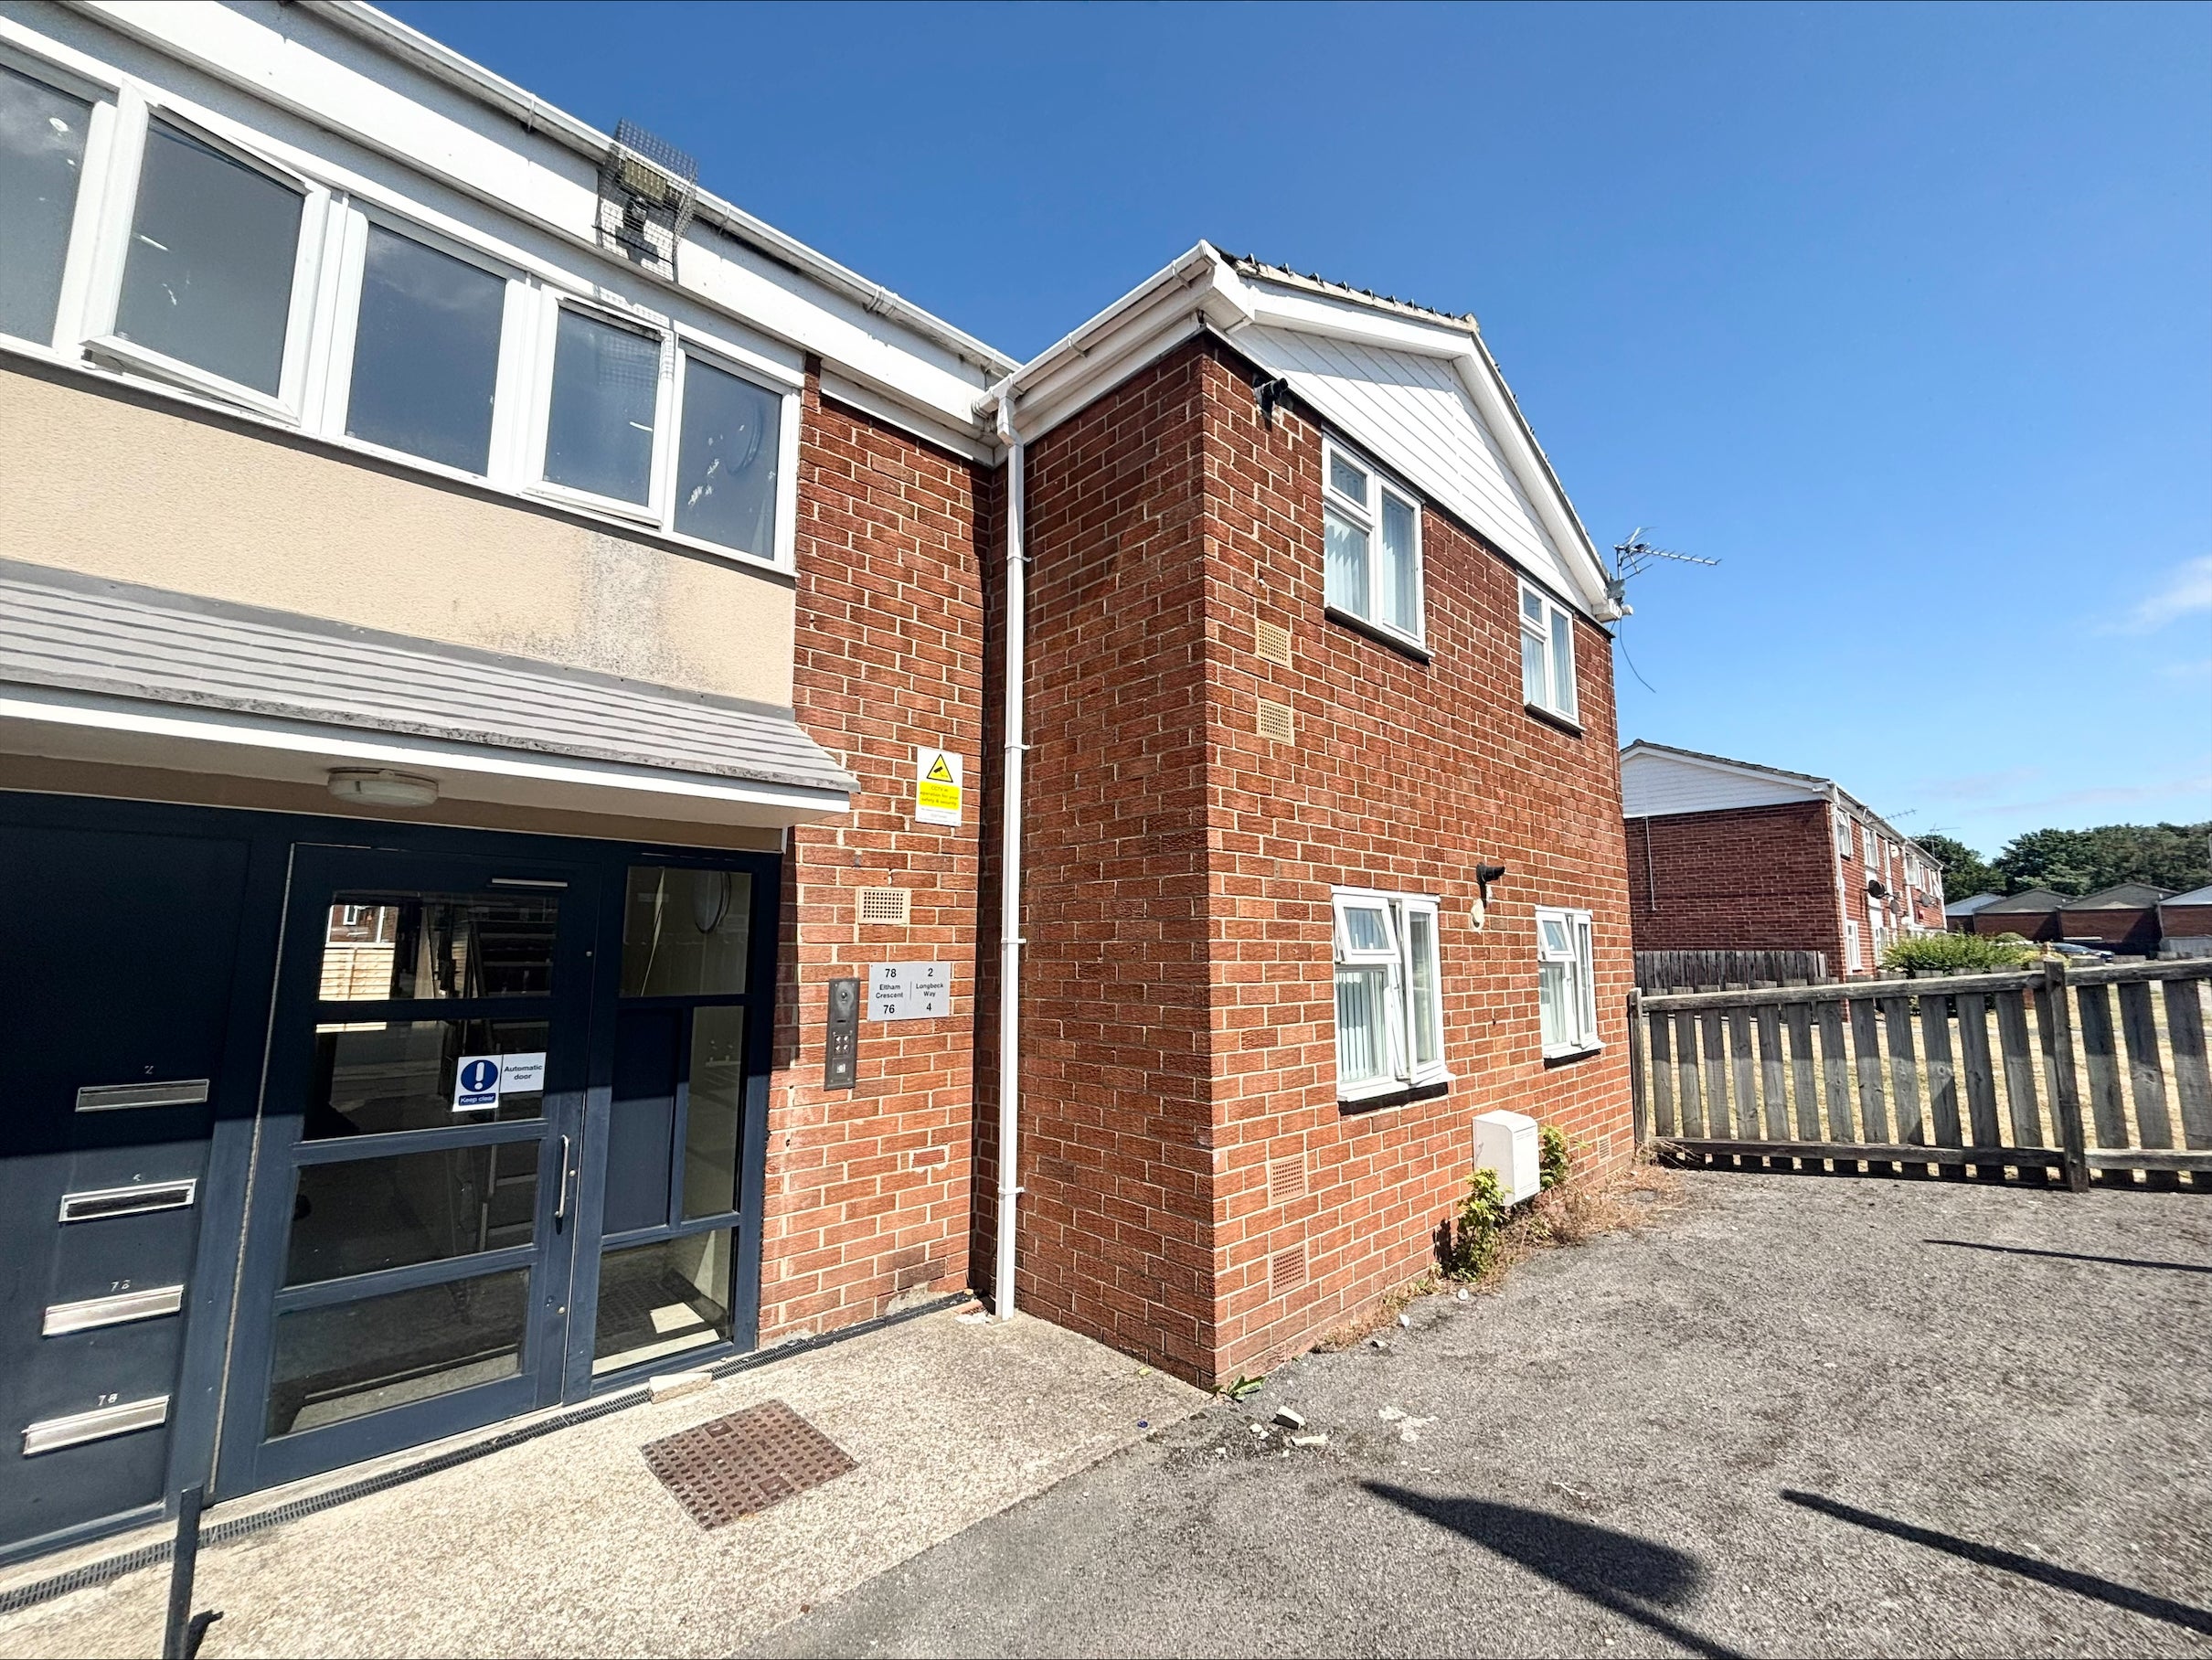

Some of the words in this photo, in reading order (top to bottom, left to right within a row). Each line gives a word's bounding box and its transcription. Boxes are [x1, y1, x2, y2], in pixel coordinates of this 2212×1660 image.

[885, 968, 897, 978] 78
[928, 968, 933, 977] 2
[883, 1005, 895, 1014] 76
[926, 1003, 931, 1011] 4
[504, 1064, 543, 1072] Automatic
